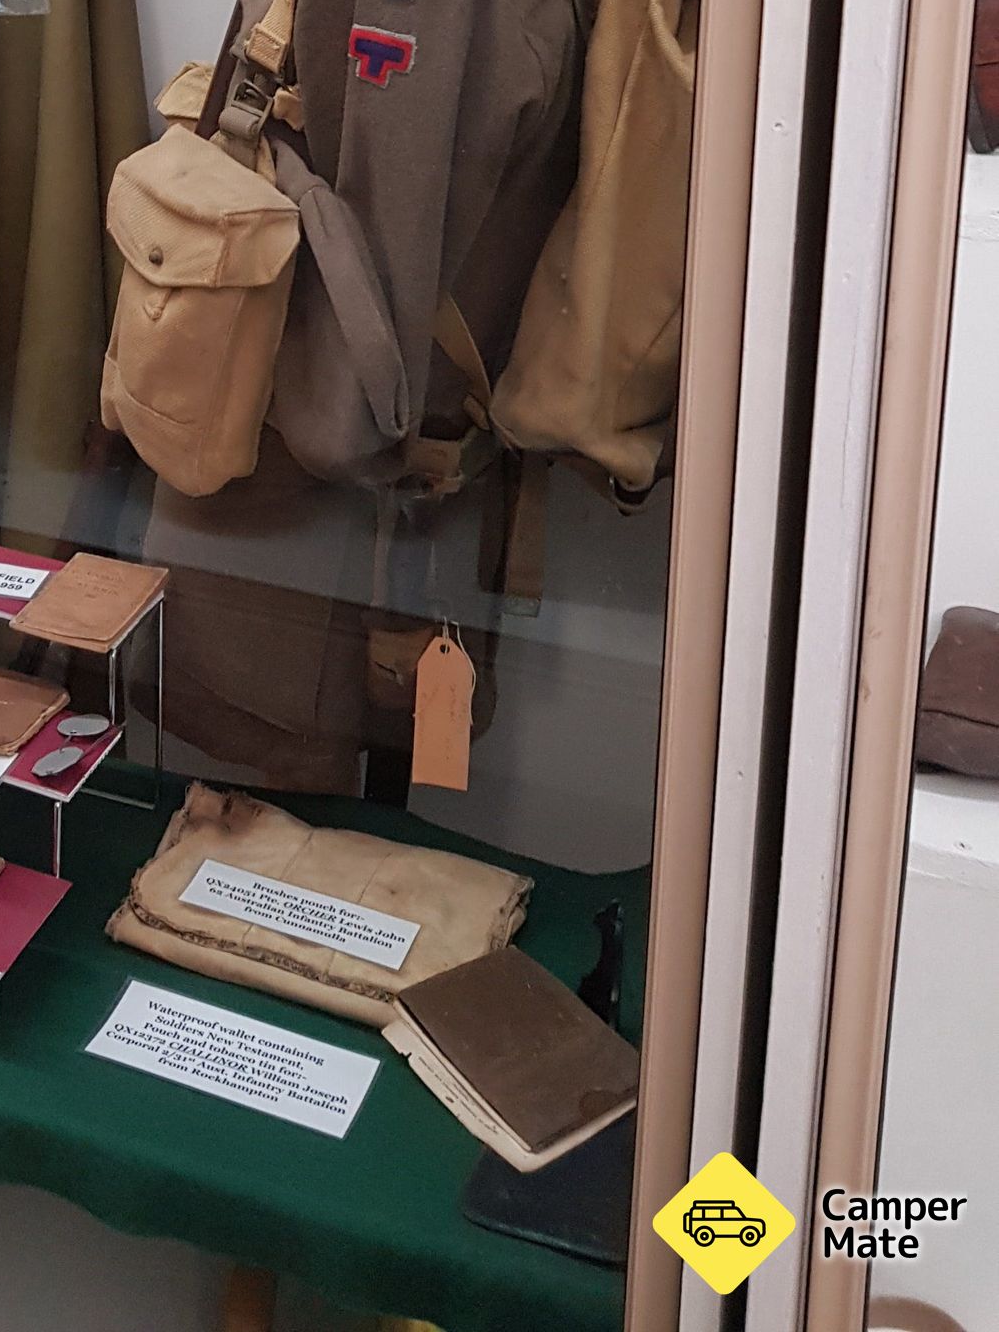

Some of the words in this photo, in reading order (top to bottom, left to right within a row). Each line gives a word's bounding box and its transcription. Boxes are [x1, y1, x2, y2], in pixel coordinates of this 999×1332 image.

[224, 892, 285, 915] Australian
[287, 911, 336, 931] Infantry
[338, 926, 393, 948] Battalion
[252, 882, 299, 902] Brushes
[300, 898, 336, 913] pouch
[259, 894, 280, 905] Pte.
[283, 901, 337, 924] ORCHER
[339, 917, 373, 934] Lewis
[374, 929, 406, 943] John
[244, 906, 272, 919] from
[275, 916, 346, 943] Cunnamulla
[143, 1022, 181, 1040] Pouch
[182, 1036, 207, 1048] and
[209, 1044, 256, 1064] tobacco
[258, 1059, 276, 1071] tin
[148, 1000, 220, 1030] Waterproof
[219, 1025, 256, 1043] wallet
[257, 1037, 325, 1066] containing
[154, 1015, 205, 1037] Soldiers
[206, 1032, 234, 1046] New
[237, 1040, 304, 1070] Testament,
[106, 1030, 161, 1053] Corporal
[196, 1061, 229, 1076] Aust.
[232, 1072, 285, 1094] Infantry
[287, 1089, 346, 1115] Battalion
[114, 1023, 167, 1045] QX12372
[168, 1041, 250, 1074] CHALLINOR
[251, 1067, 300, 1089] William
[302, 1085, 348, 1105] Joseph
[158, 1056, 189, 1072] from
[191, 1068, 279, 1102] Rockhampton
